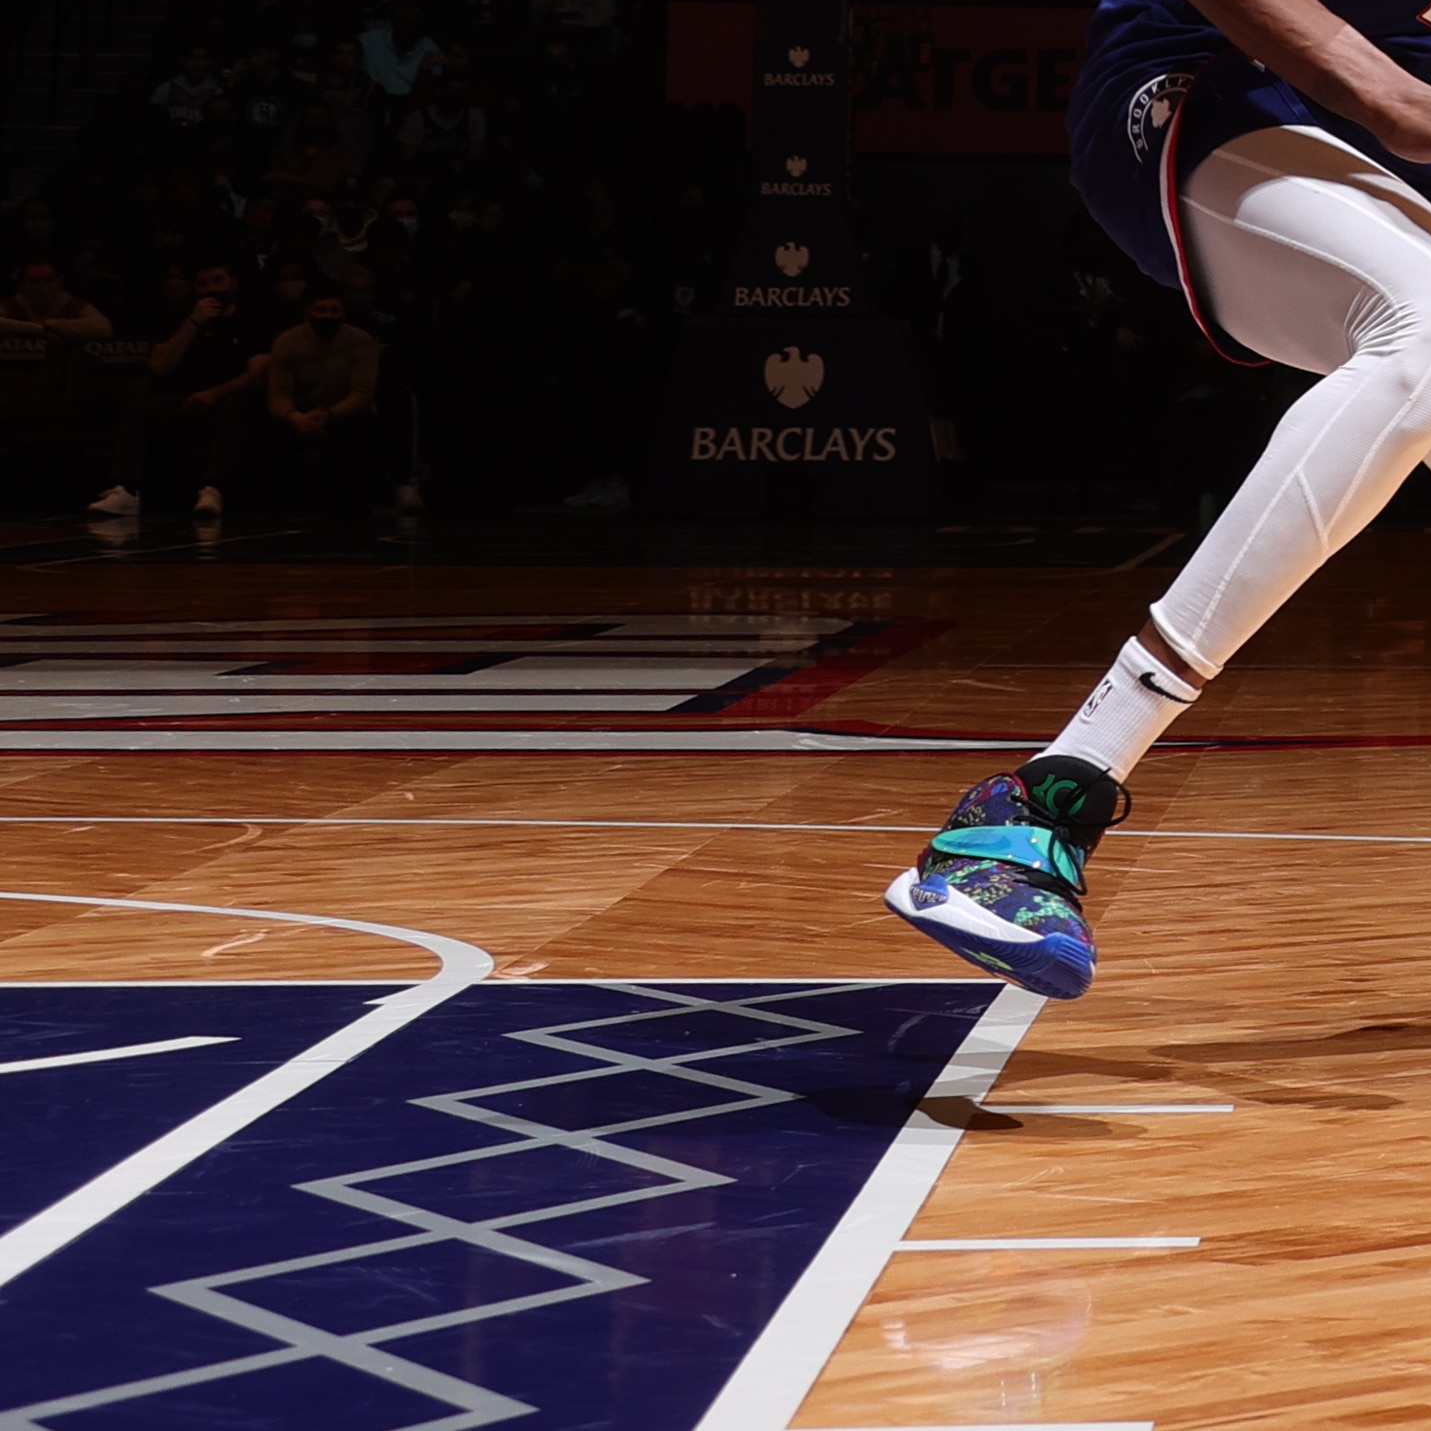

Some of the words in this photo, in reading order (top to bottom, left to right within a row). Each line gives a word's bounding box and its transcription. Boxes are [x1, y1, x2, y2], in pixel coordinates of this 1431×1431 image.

[763, 72, 836, 87] BARCLAYS
[760, 181, 833, 197] BARCLAYS
[733, 285, 852, 308] BARCLAYS
[690, 426, 898, 463] BARCLAYS
